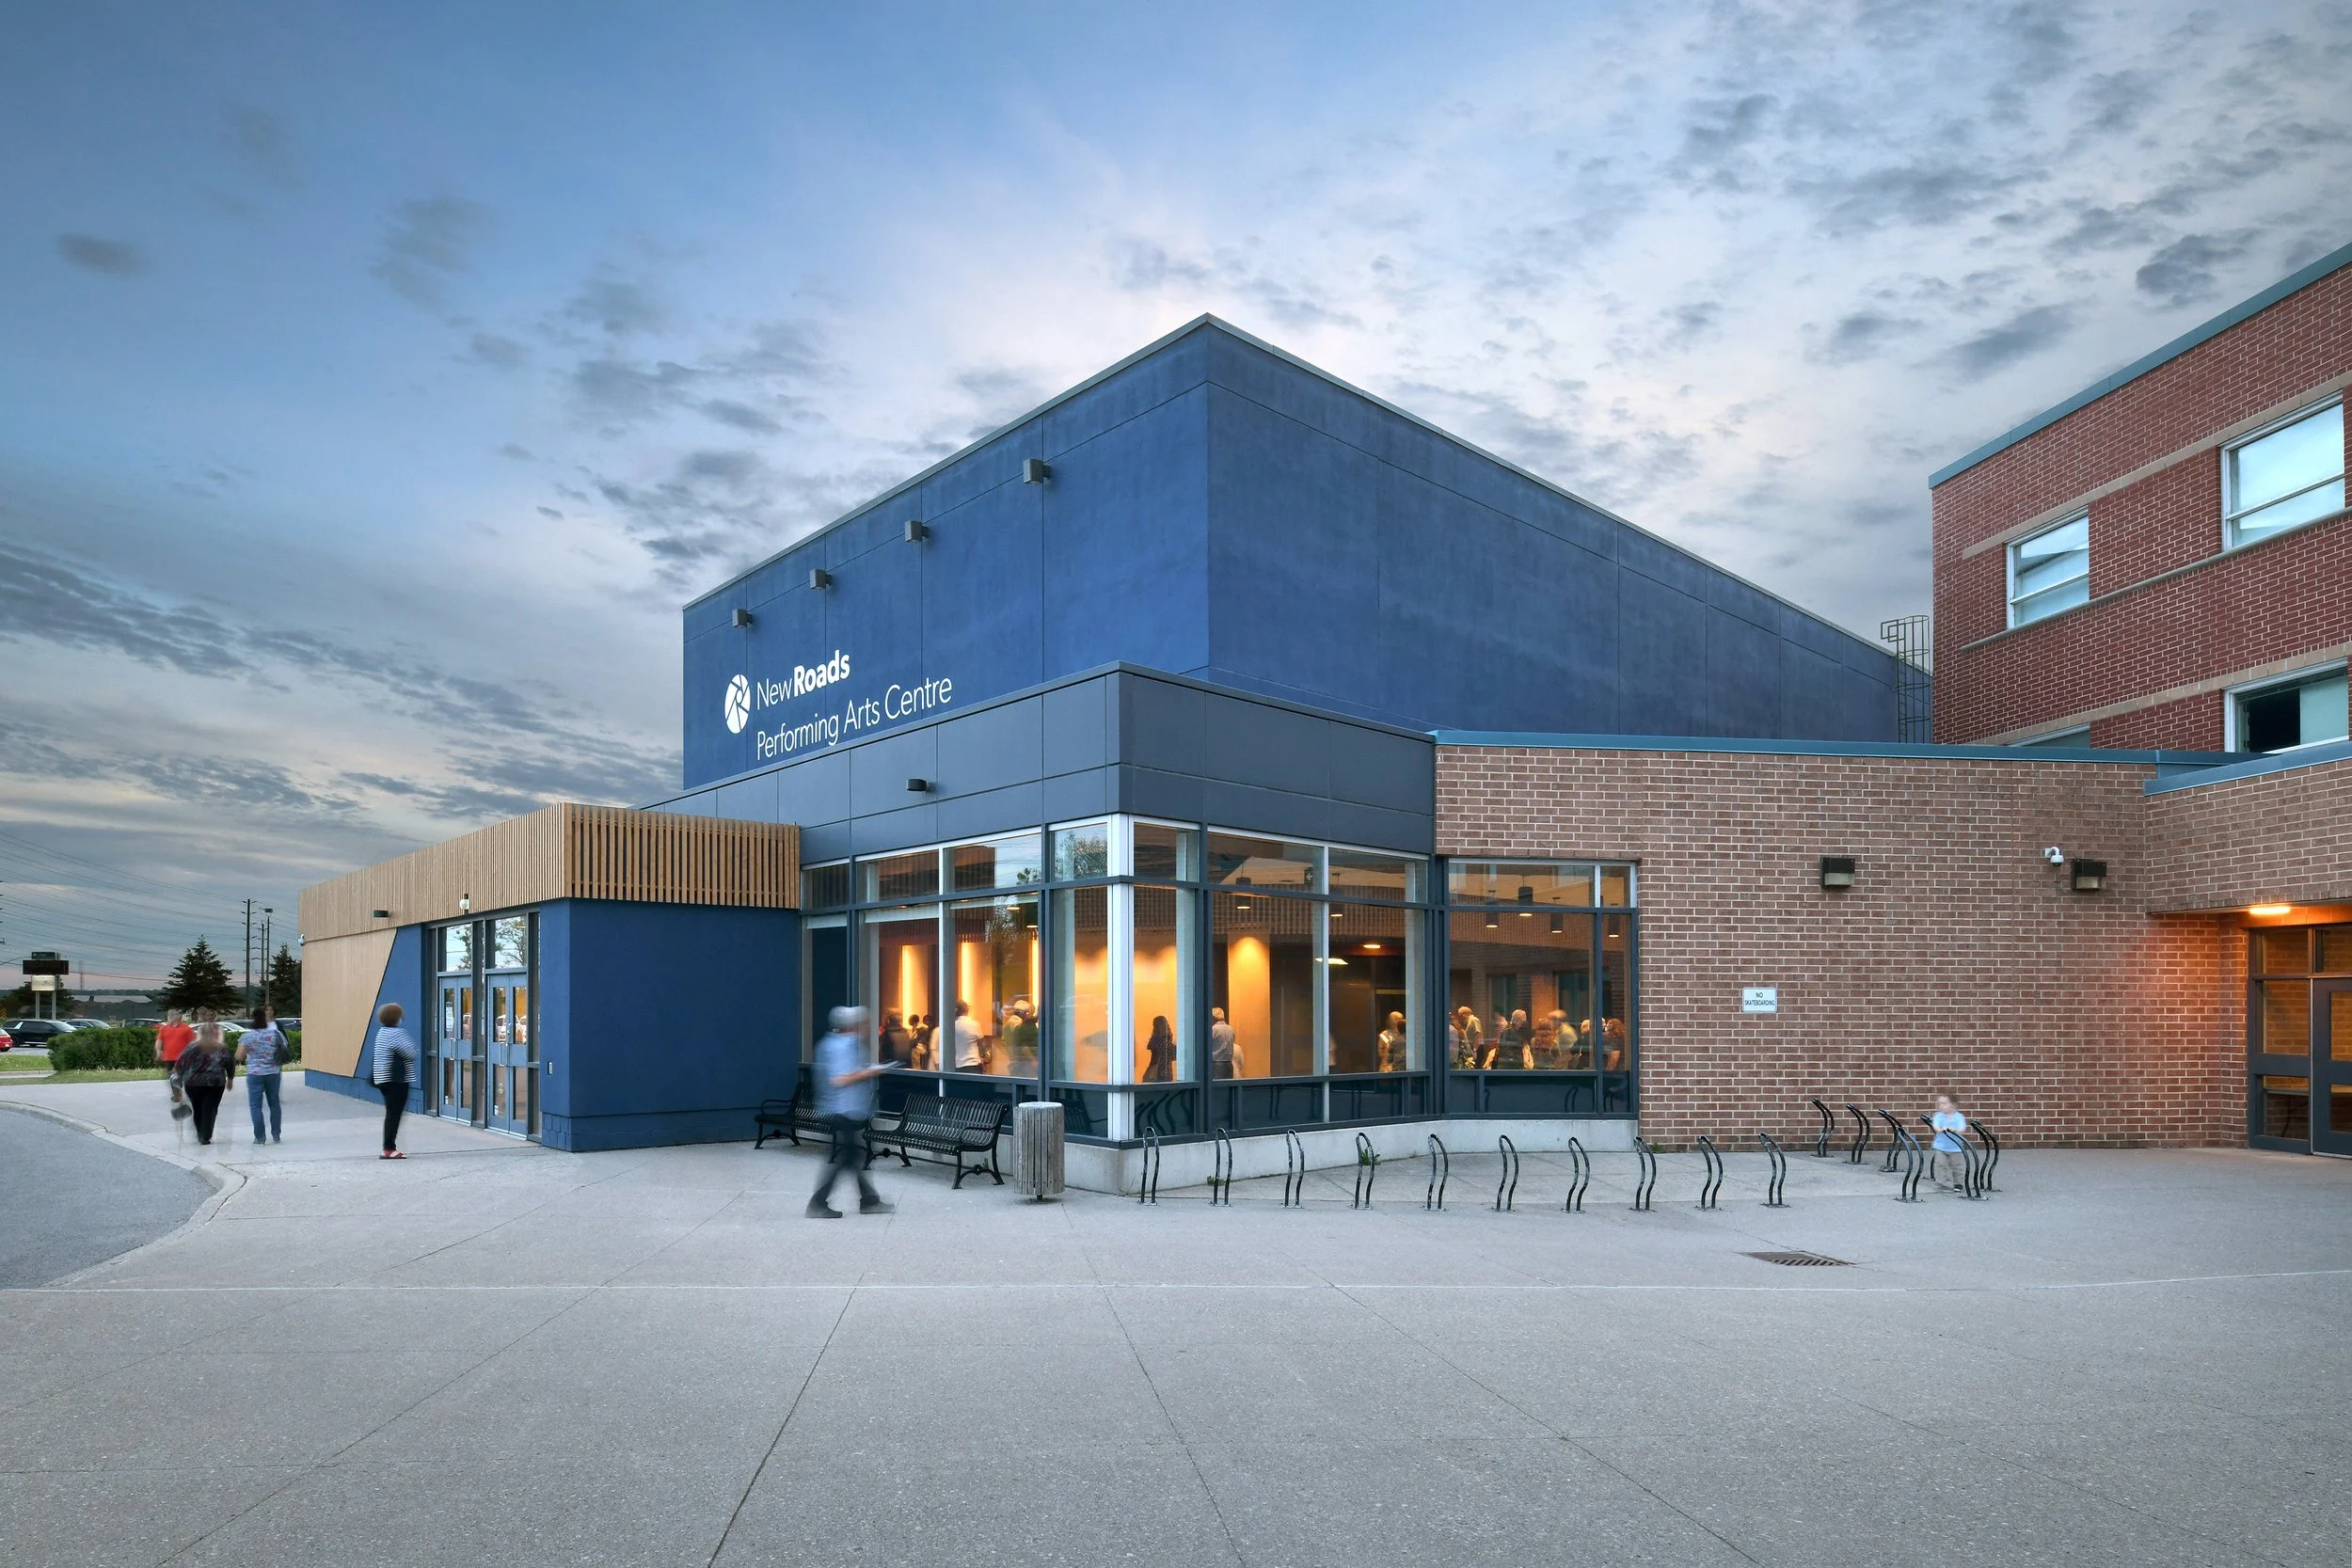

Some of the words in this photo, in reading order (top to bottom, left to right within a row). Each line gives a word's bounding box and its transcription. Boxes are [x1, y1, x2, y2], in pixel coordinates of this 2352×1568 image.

[756, 712, 839, 761] Performing
[843, 698, 881, 734] Arts
[884, 677, 953, 720] Centre
